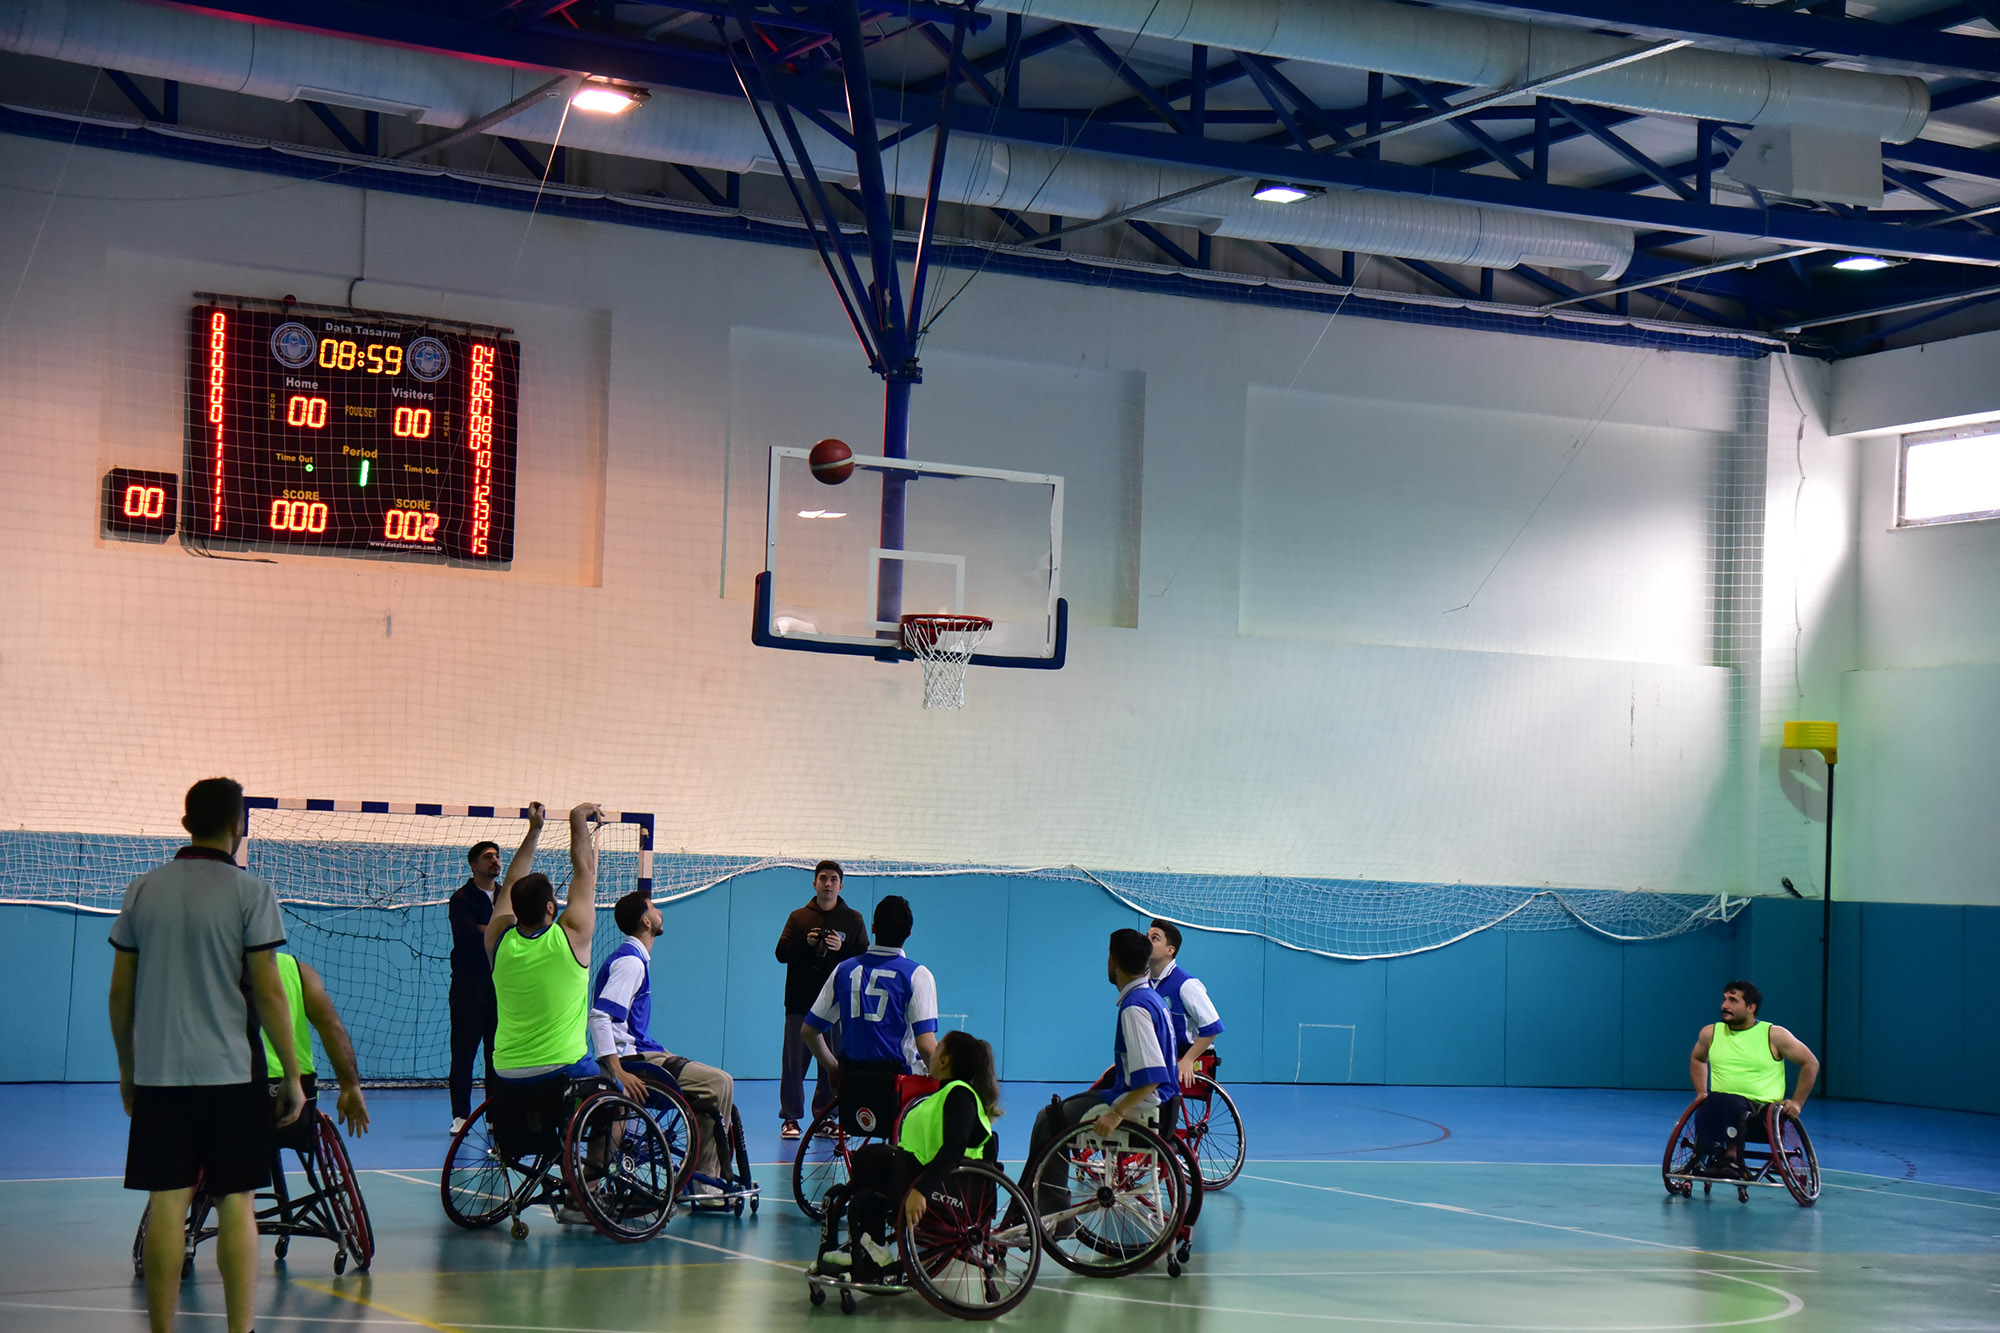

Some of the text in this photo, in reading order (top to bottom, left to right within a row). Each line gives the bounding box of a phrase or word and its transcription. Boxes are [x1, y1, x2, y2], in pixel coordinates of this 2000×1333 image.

[325, 322, 352, 333] Data
[318, 338, 403, 375] 08:59
[472, 345, 495, 363] 04
[472, 362, 494, 381] 05
[286, 377, 319, 390] Home
[471, 380, 493, 399] 06
[391, 387, 434, 401] Visitors
[287, 396, 328, 428] 00
[470, 398, 493, 415] 07
[393, 407, 432, 439] 00
[470, 415, 492, 433] 08
[469, 432, 492, 450] 09
[276, 453, 314, 463] Time Out
[342, 446, 377, 459] Period
[475, 450, 492, 468] 10
[403, 465, 439, 475] Time Out
[474, 468, 491, 485] 11
[124, 485, 165, 518] 00
[282, 490, 320, 501] SCORE
[474, 485, 490, 503] 12
[396, 499, 431, 510] SCORE
[473, 502, 490, 520] 13
[270, 500, 328, 533] 000
[384, 509, 440, 542] 002
[472, 520, 490, 537] 14
[471, 537, 488, 555] 15
[849, 965, 897, 1022] 15
[931, 1191, 964, 1209] EXTRA
[819, 1195, 831, 1244] EXTRA
